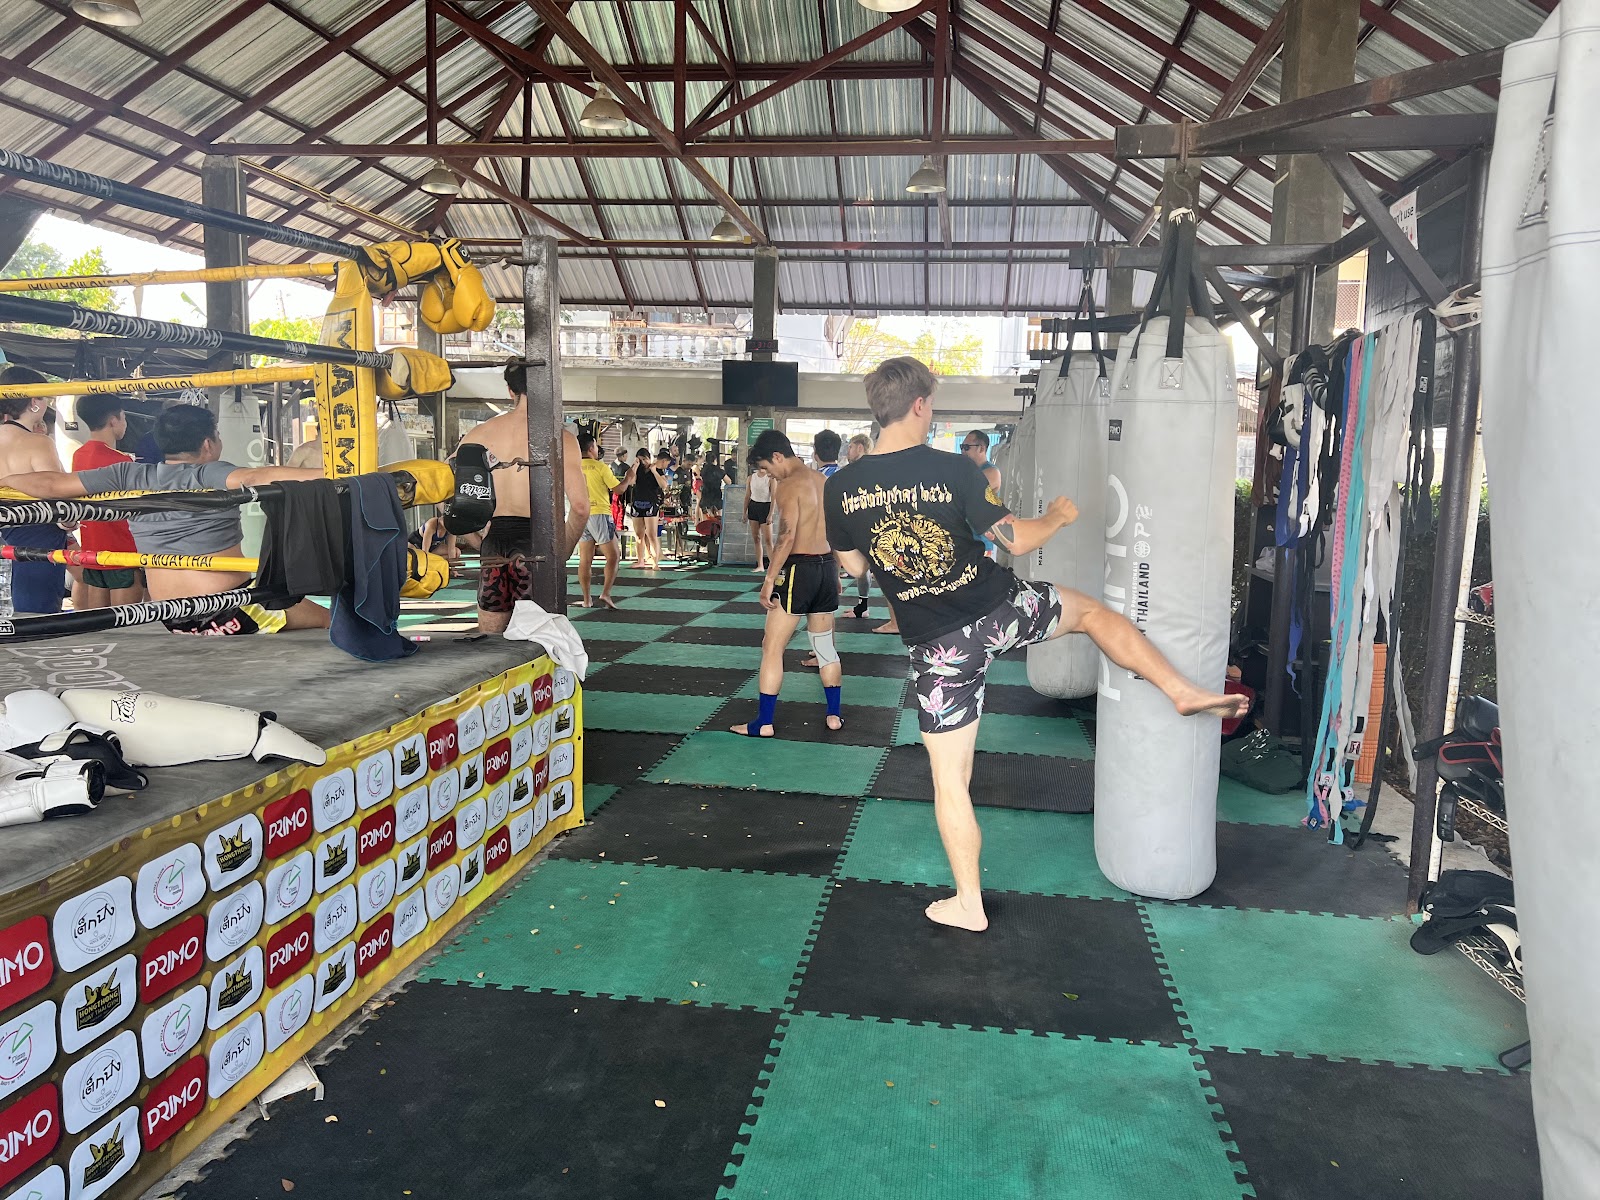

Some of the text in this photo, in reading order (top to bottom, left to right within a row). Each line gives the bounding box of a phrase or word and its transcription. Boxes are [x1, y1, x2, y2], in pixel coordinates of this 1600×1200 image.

[69, 309, 156, 340] HONGTONG
[1136, 562, 1151, 624] THAILAND
[114, 600, 192, 627] HONGTONG
[486, 751, 509, 775] PRIMO
[268, 807, 308, 845] PRIMO
[360, 820, 392, 854] PRIMO
[219, 844, 252, 863] HONGTHONG
[486, 837, 508, 865] PRIMO
[145, 939, 199, 988] PRIMO
[269, 931, 309, 975] PRIMO
[359, 928, 390, 966] PRIMO
[79, 991, 119, 1017] HONGTHONG
[147, 1077, 202, 1135] PRIMO
